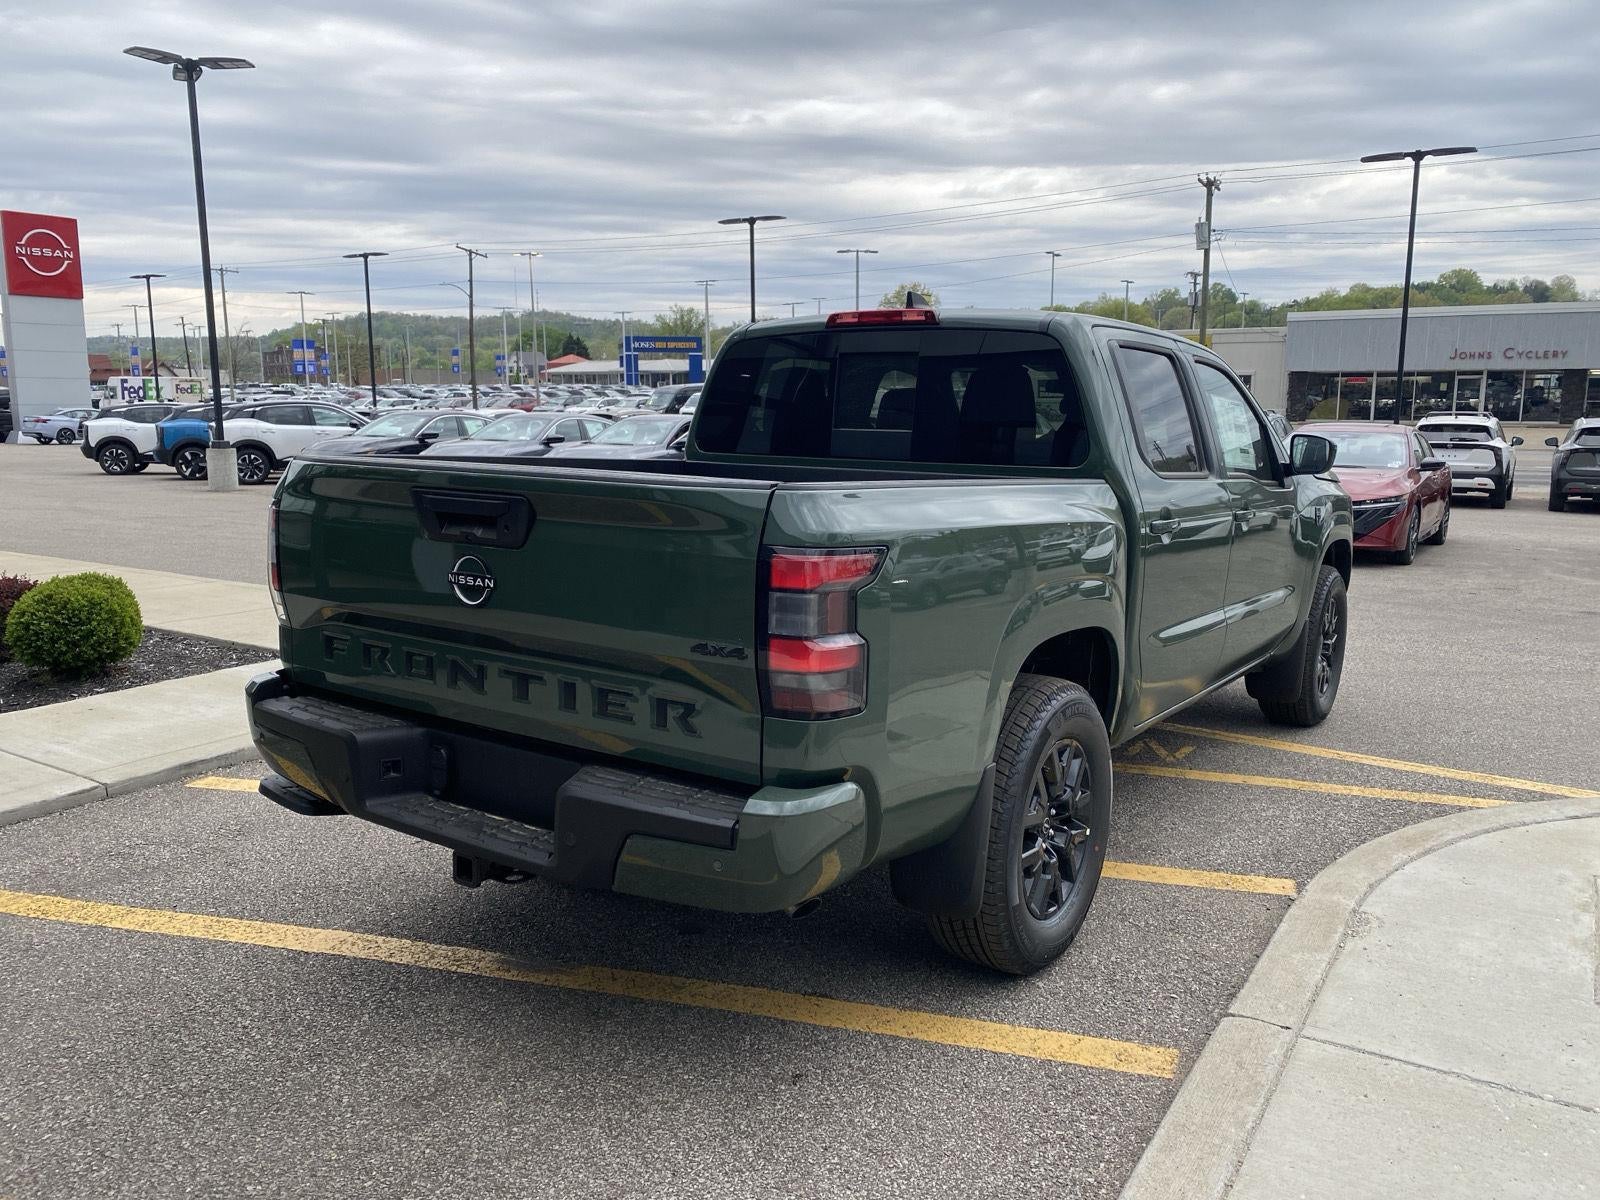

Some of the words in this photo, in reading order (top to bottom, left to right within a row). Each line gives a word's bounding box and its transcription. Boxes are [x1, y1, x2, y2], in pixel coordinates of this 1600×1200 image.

[15, 246, 73, 258] NISSAN
[1449, 348, 1492, 360] JOHNS
[1503, 347, 1568, 359] CYCLERY
[120, 378, 163, 400] FedEx
[175, 383, 204, 394] FedEx
[448, 573, 494, 588] NISSAN
[321, 630, 703, 738] FRONTIER
